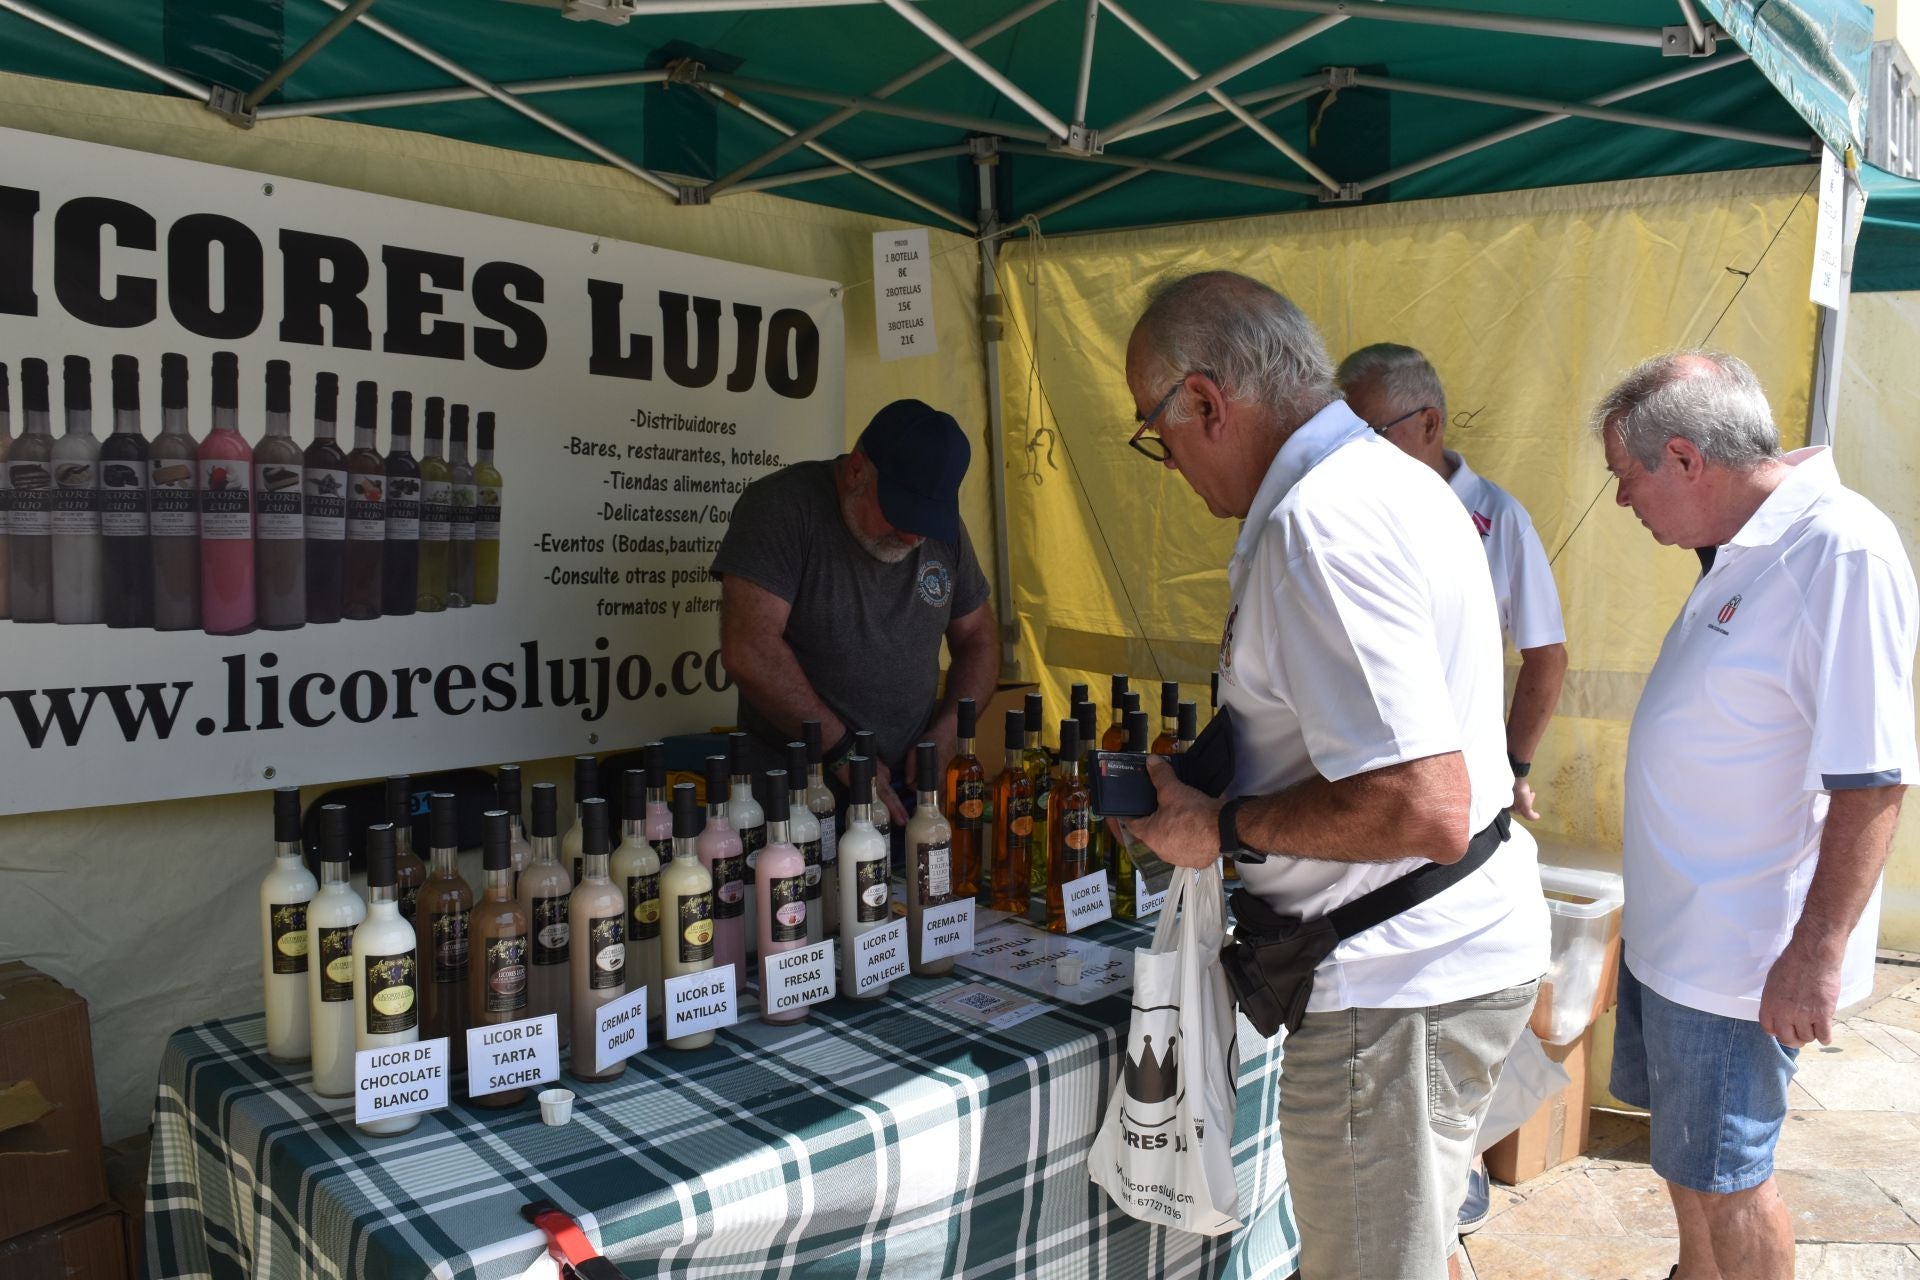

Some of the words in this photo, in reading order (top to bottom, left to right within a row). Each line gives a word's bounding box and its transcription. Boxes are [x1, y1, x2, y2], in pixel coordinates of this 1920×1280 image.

[885, 254, 889, 263] 1
[891, 251, 919, 262] BOTELLA
[898, 268, 907, 277] 8€
[886, 285, 921, 297] 2BOTELLAS
[898, 301, 911, 311] 15€
[888, 318, 924, 331] 3BOTELLAS
[587, 278, 819, 399] LUJO
[901, 335, 914, 345] 21€
[630, 409, 736, 435] -Distribuidores
[563, 437, 621, 461] -Bares,
[627, 443, 726, 467] restaurantes,
[603, 471, 668, 492] -Tiendas
[534, 533, 604, 553] -Eventos
[544, 566, 619, 585] -Consulte
[626, 568, 666, 584] otras
[597, 598, 667, 616] formatos
[672, 601, 680, 618] y
[1071, 888, 1090, 901] LICOR
[1092, 884, 1101, 894] DE
[1072, 900, 1104, 917] NARANJA
[1142, 896, 1167, 912] ESPECIA
[927, 916, 955, 931] CREMA
[957, 912, 968, 922] DE
[863, 933, 886, 951] LICOR
[888, 929, 899, 940] DE
[934, 933, 959, 946] TRUFA
[981, 937, 1036, 955] BOTELLA
[779, 953, 808, 970] LICOR
[811, 949, 824, 961] DE
[868, 948, 896, 967] ARROZ
[785, 969, 821, 987] FRESAS
[860, 972, 879, 988] CON
[881, 963, 905, 980] LECHE
[677, 986, 709, 1003] LICOR
[712, 982, 725, 994] DE
[777, 994, 799, 1008] CON
[802, 985, 829, 1006] NATA
[602, 1013, 629, 1033] CREMA
[631, 1004, 642, 1017] DE
[676, 1001, 727, 1023] NATILLAS
[483, 1026, 522, 1045] LICOR
[526, 1023, 543, 1036] DE
[608, 1028, 634, 1050] ORUJO
[371, 1051, 410, 1068] LICOR
[415, 1047, 431, 1060] DE
[492, 1047, 536, 1066] TARTA
[360, 1066, 441, 1091] CHOCOLATE
[490, 1068, 541, 1089] SACHER
[374, 1088, 428, 1109] BLANCO
